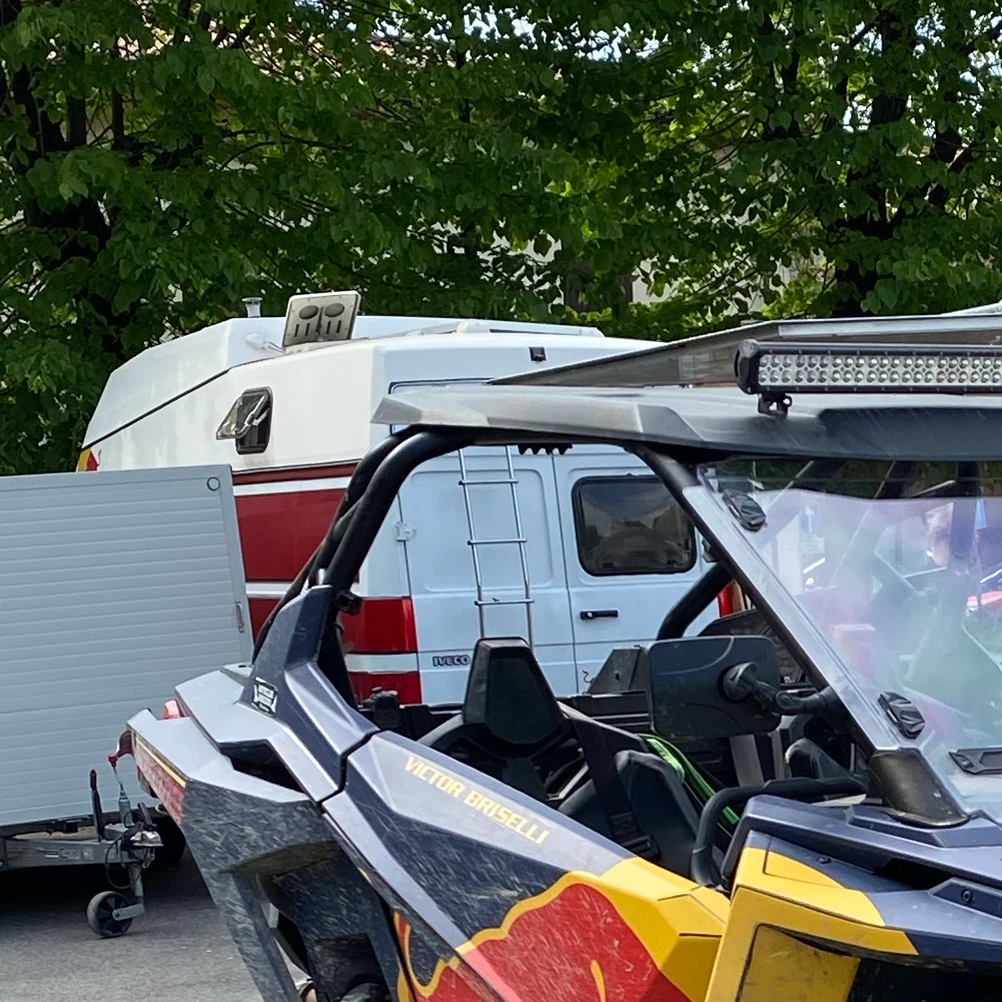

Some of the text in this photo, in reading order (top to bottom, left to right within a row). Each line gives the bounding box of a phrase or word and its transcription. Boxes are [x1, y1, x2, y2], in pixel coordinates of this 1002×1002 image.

[432, 654, 472, 667] IVECO
[404, 755, 550, 845] VICTOR BRISELLI
